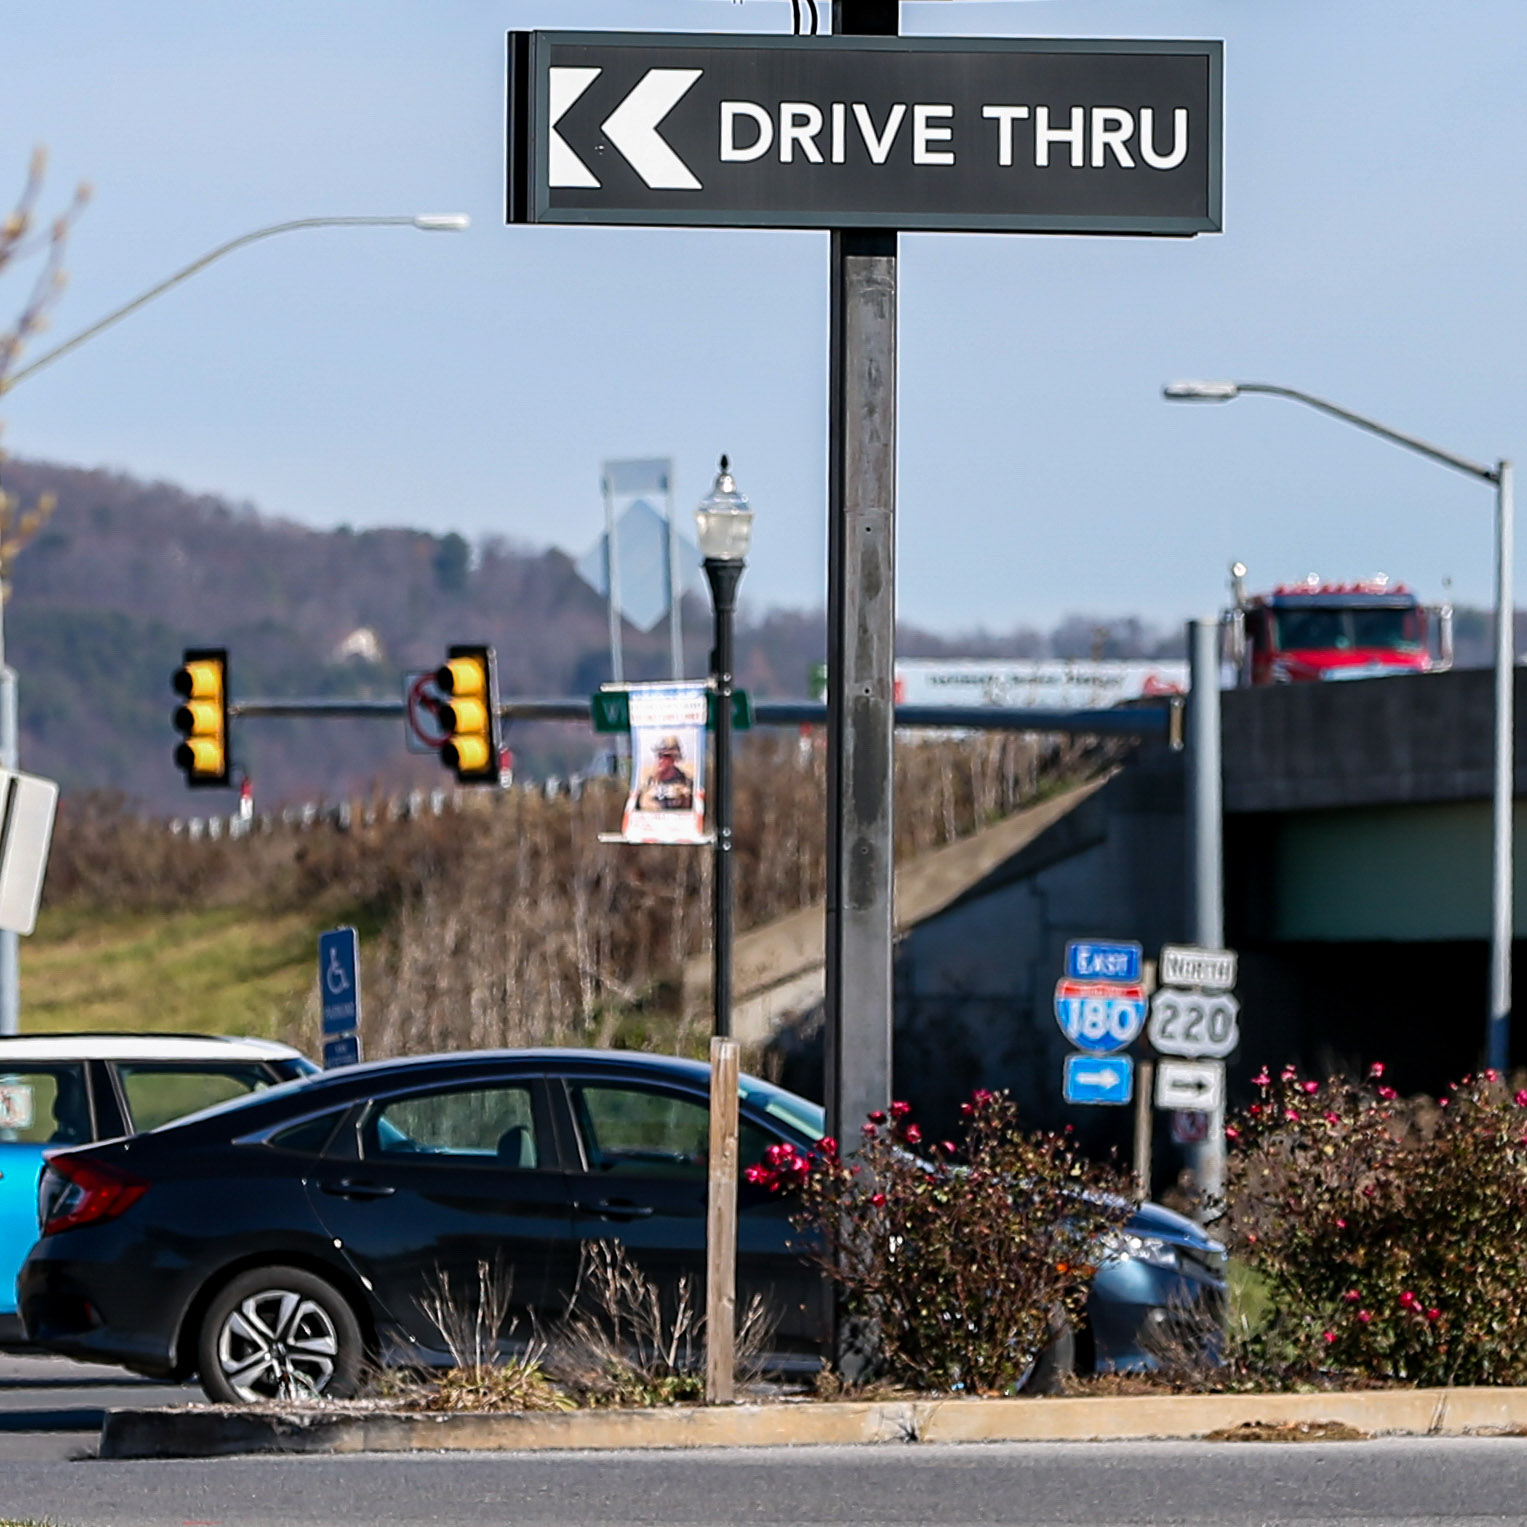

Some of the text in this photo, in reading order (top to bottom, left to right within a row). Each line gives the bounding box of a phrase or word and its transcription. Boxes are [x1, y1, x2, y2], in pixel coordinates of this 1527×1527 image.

[720, 101, 1189, 169] DRIVE THRU
[1067, 998, 1138, 1042] 180
[1160, 1004, 1233, 1044] 220
